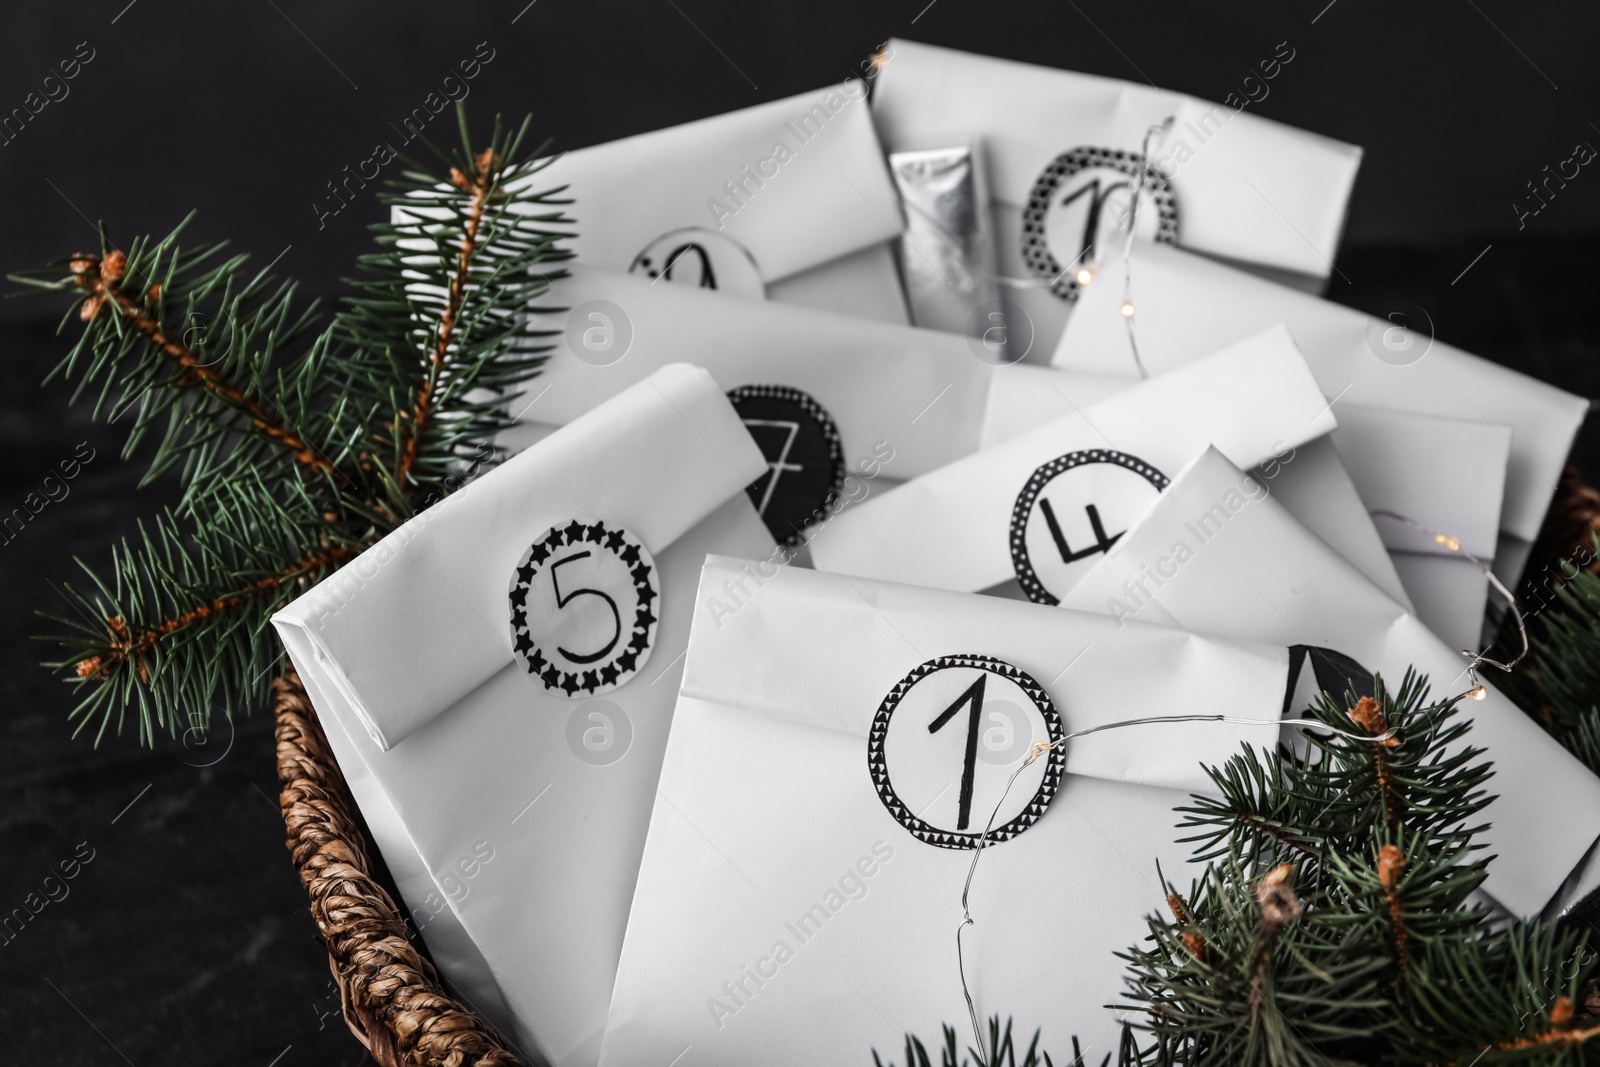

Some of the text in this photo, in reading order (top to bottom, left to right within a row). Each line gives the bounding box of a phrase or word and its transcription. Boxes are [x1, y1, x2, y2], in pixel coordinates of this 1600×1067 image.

[743, 419, 803, 517] 7
[551, 551, 621, 664] 5
[928, 673, 987, 830] 1
